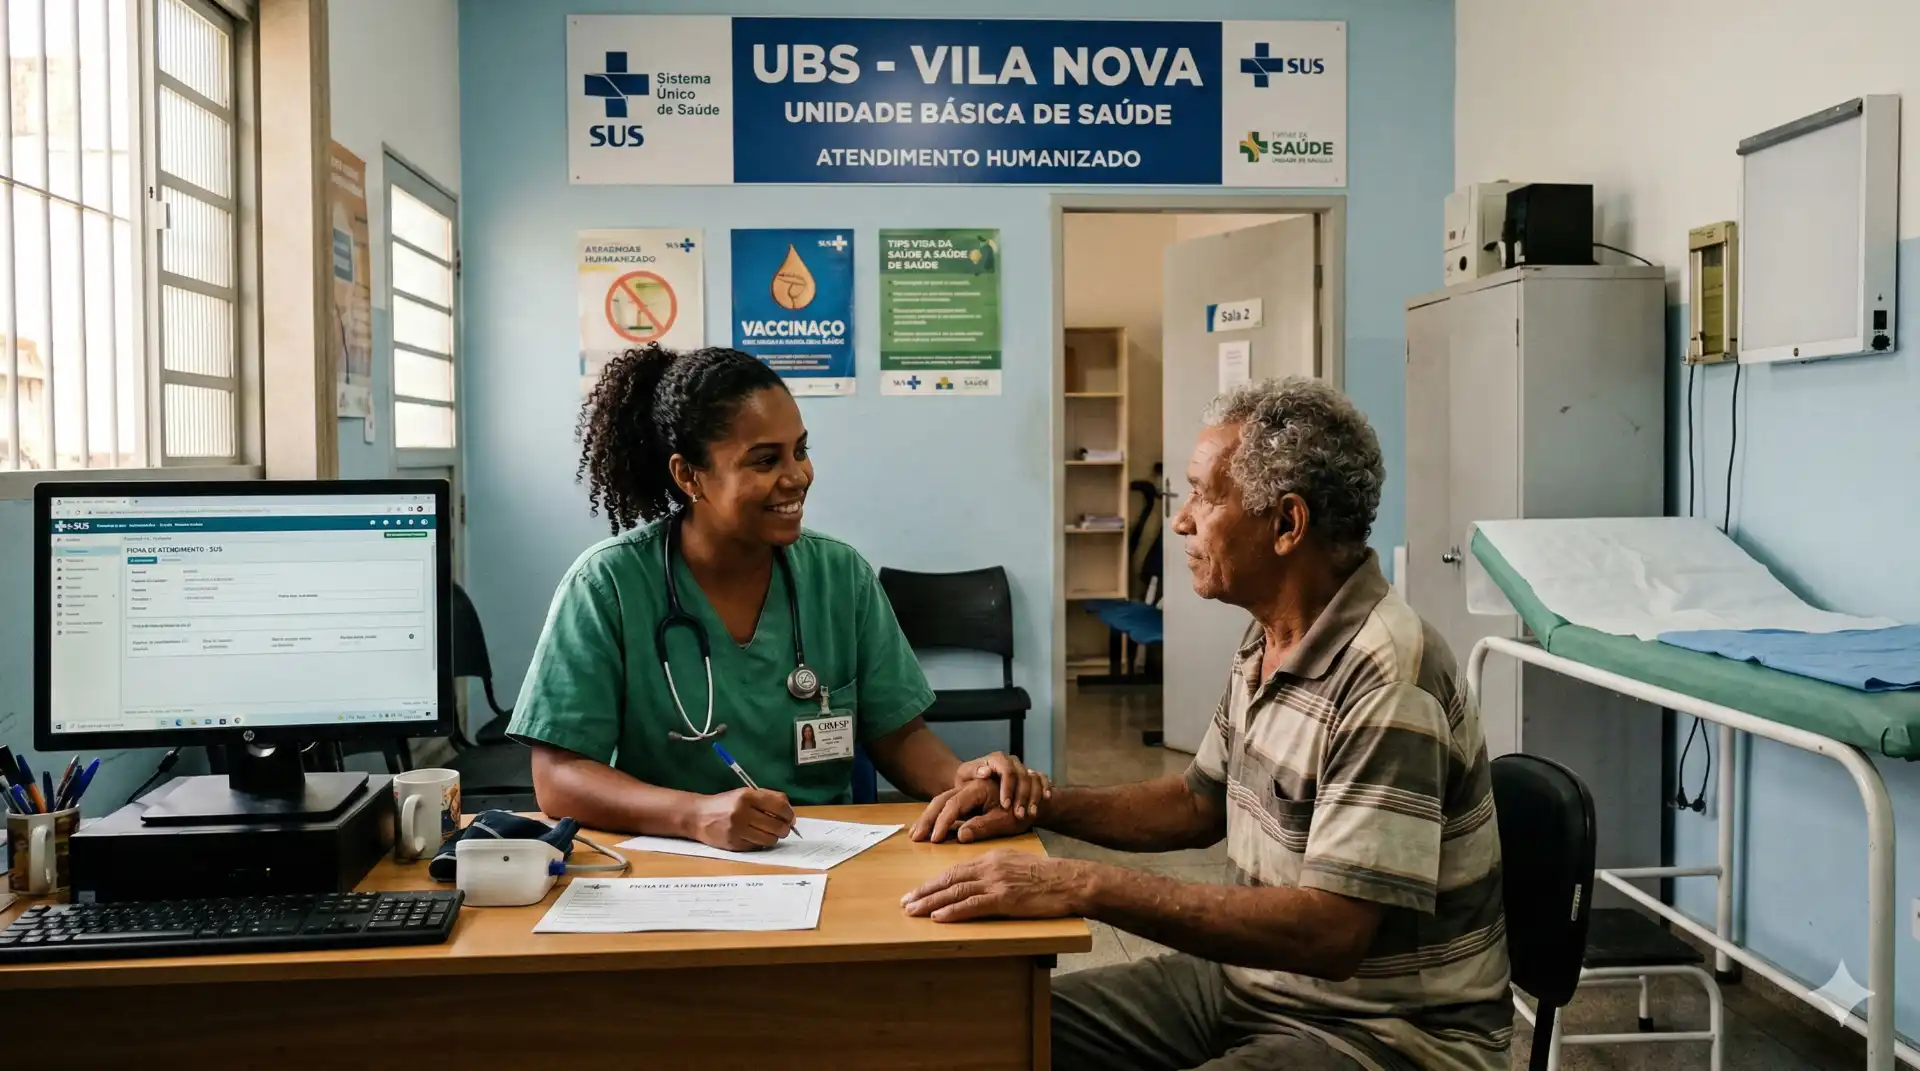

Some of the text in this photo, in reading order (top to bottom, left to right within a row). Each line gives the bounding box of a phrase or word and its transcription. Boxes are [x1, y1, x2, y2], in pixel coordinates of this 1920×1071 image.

[753, 43, 1204, 87] UBS - VILA NOVA
[1287, 58, 1324, 75] SUS
[656, 72, 711, 85] Sistema
[656, 85, 696, 100] Único
[656, 103, 720, 116] de Saúde
[784, 97, 1172, 126] UNIDADE BÁSICA DE SAÚDE
[589, 125, 645, 148] SUS
[1272, 138, 1334, 156] SAÚDE
[815, 148, 1141, 169] ATENDIMENTO HUMANIZADO
[933, 248, 968, 259] SAÚDE
[888, 258, 939, 270] DE SAÚDE
[1221, 308, 1250, 323] Sala 2
[741, 319, 846, 339] VACCINAÇO
